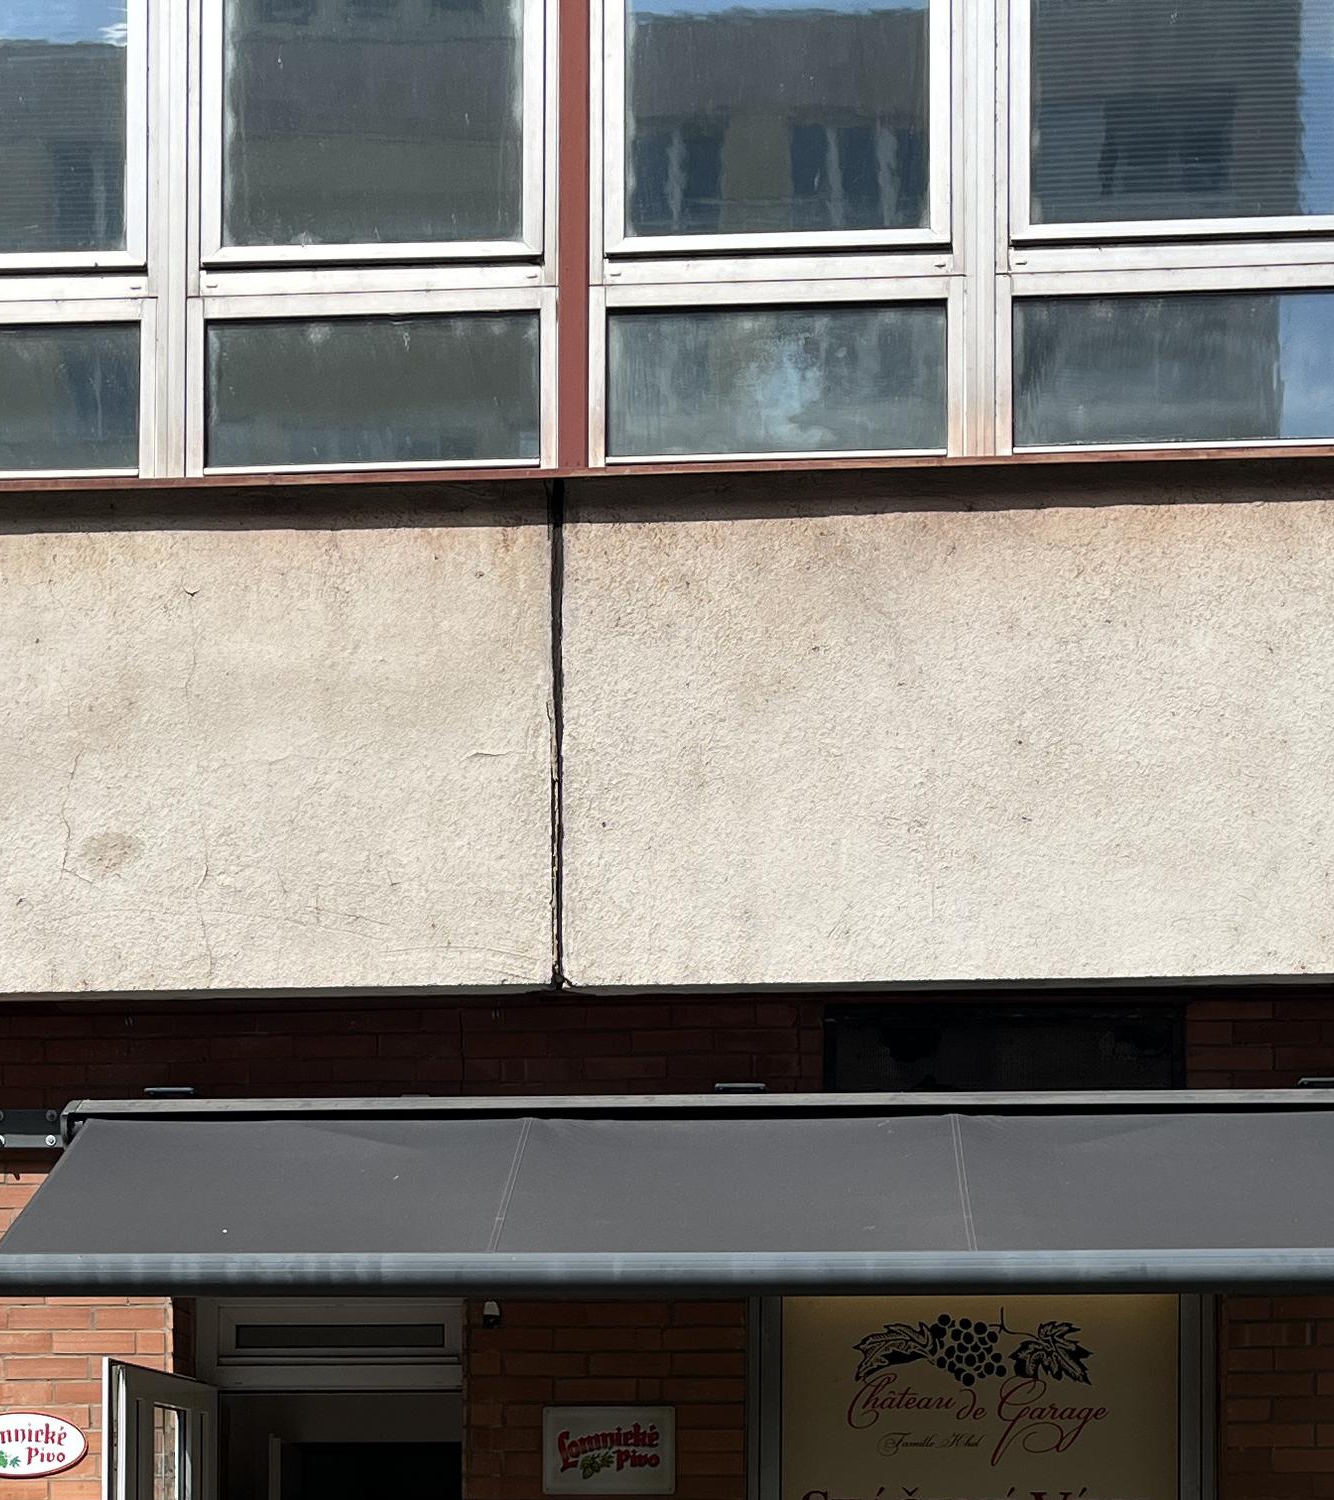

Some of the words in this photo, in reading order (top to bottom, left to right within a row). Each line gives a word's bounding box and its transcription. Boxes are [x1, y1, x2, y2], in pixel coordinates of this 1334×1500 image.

[847, 1373, 957, 1430] Château
[955, 1389, 987, 1420] de
[990, 1375, 1109, 1467] Garage
[25, 1446, 66, 1465] Pivo
[557, 1422, 660, 1472] Lomnické
[614, 1450, 660, 1471] Pivo
